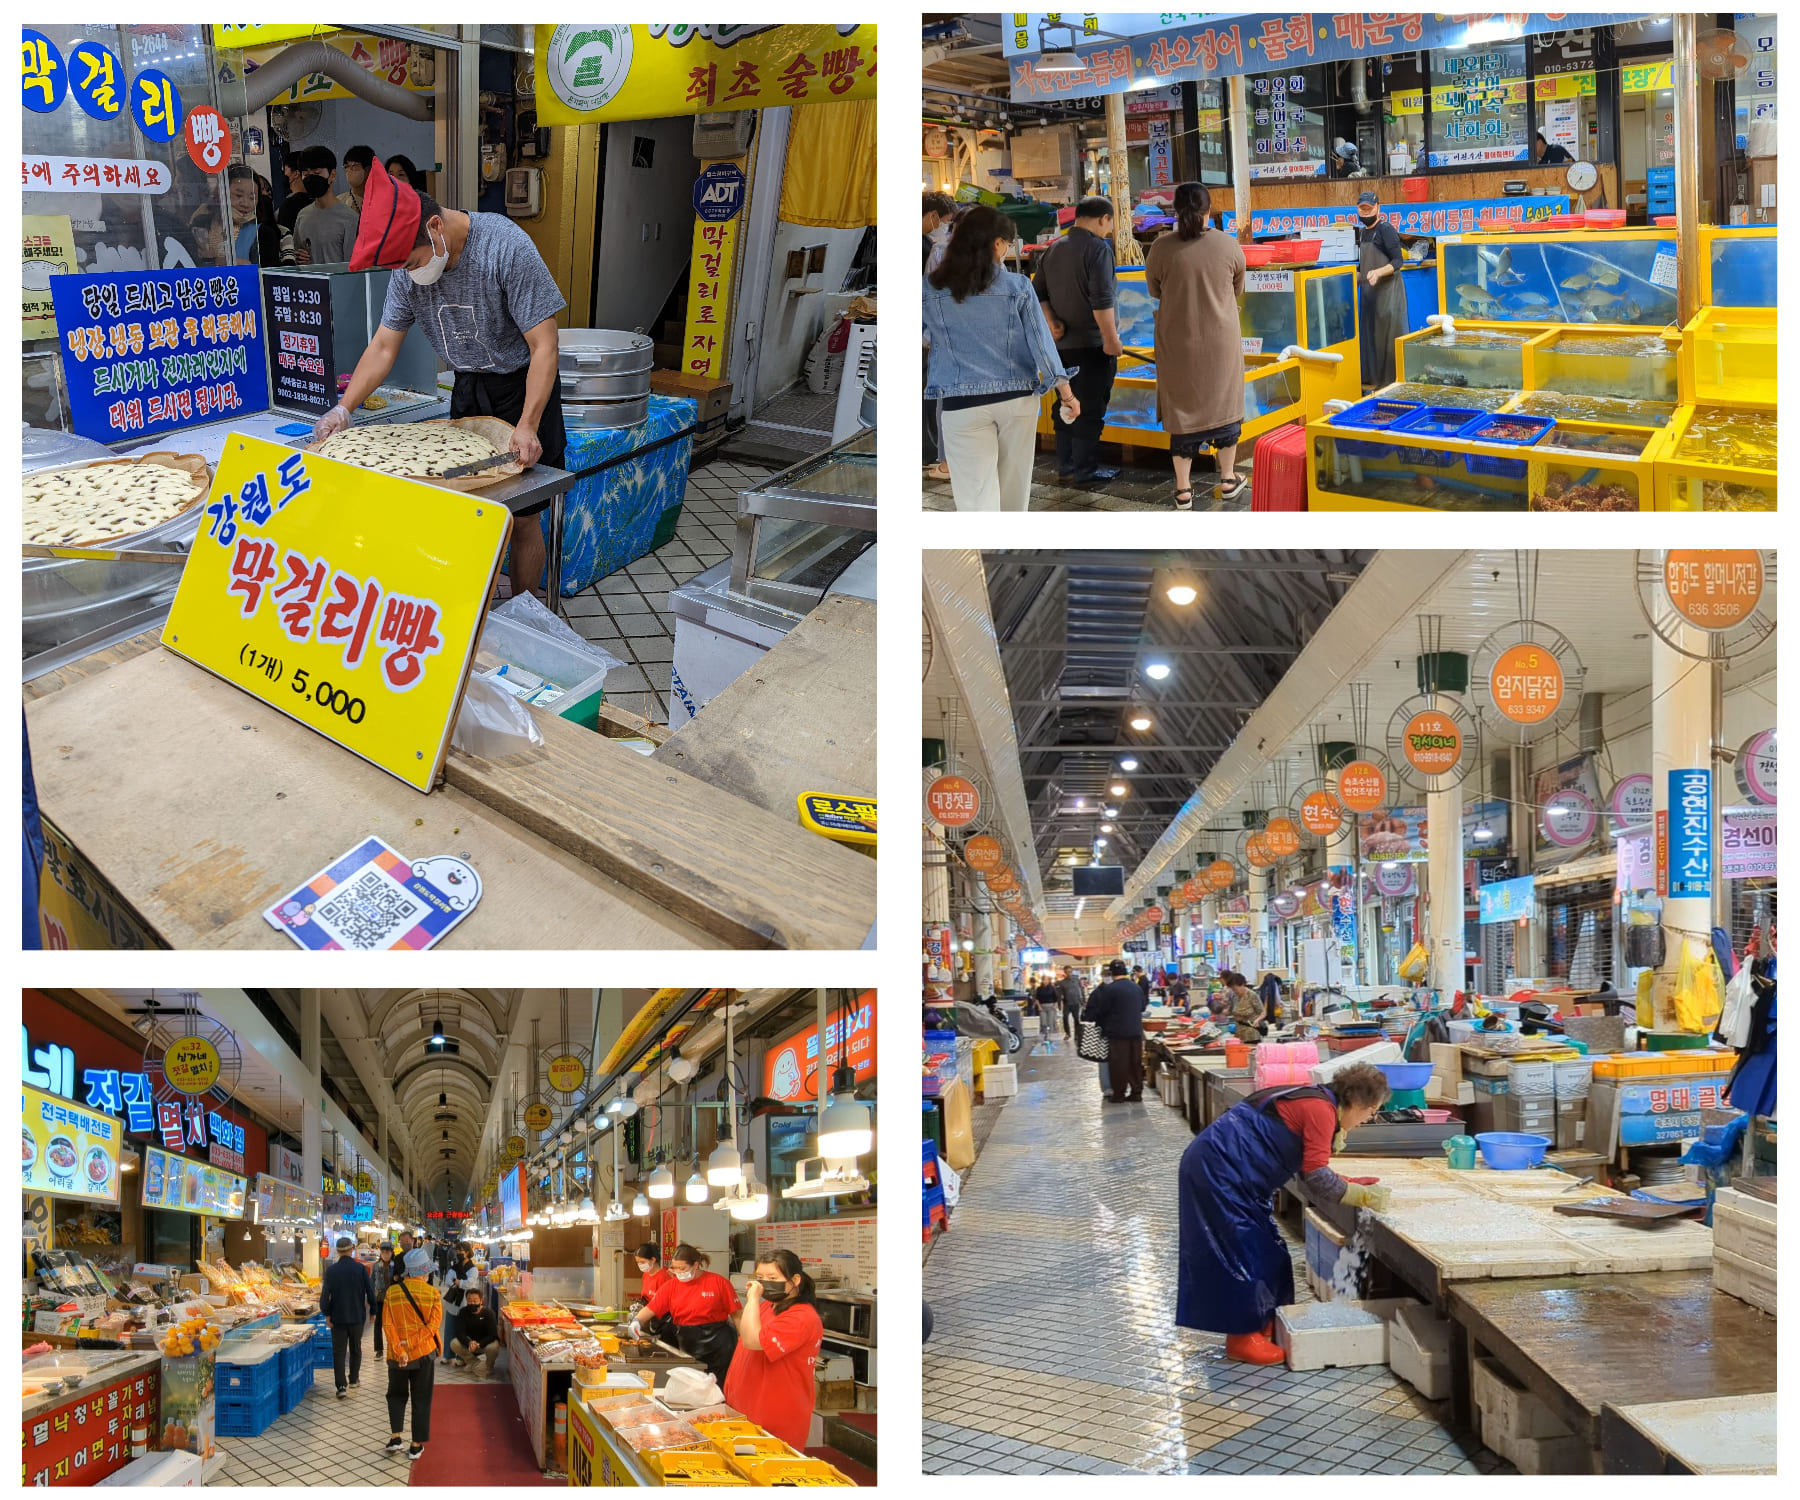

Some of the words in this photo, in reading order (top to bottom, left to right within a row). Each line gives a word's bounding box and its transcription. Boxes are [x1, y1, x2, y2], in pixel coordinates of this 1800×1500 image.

[1147, 24, 1244, 77] 산오징어
[1257, 12, 1315, 61] 물회
[685, 61, 763, 107] 최초
[61, 162, 162, 188] 주의하세요
[701, 181, 740, 204] ADT
[82, 283, 121, 320] 당일
[125, 281, 173, 313] 드시고
[176, 278, 206, 310] 남은
[209, 275, 239, 308] 빵은
[272, 286, 290, 303] 평일
[297, 289, 321, 305] 9:30
[149, 318, 180, 349] 보관
[182, 318, 198, 347] 후
[201, 309, 257, 345] 해동해서
[274, 306, 292, 323] 주말
[299, 309, 322, 326] 8:30
[282, 334, 318, 353] 정기휴일
[93, 356, 160, 396] 드시거나
[162, 345, 247, 386] 전자레인지에
[278, 352, 296, 369] 매주
[297, 355, 325, 376] 수요일
[109, 397, 144, 432] 데워
[148, 391, 192, 424] 드시면
[191, 381, 243, 416] 됩니다.
[207, 452, 312, 546] 강원도
[1668, 561, 1700, 595] 함경도
[1703, 561, 1757, 595] 할머니젓갈
[229, 537, 441, 688] 막걸리빵
[1688, 603, 1709, 616] 636
[1713, 603, 1741, 616] 3506
[239, 643, 284, 682] (1개)
[290, 668, 366, 724] 5,000
[1496, 674, 1558, 699] 엄지닭집
[1508, 704, 1524, 715] 633
[1526, 704, 1547, 715] 9347
[1420, 721, 1443, 732] 11호
[1408, 734, 1456, 751] 경선이네
[932, 792, 975, 810] 대경젓갈
[1681, 774, 1709, 878] 공현진수산
[172, 1063, 189, 1076] 젓갈
[190, 1062, 208, 1076] 멸치
[84, 1068, 155, 1132] 젓갈
[157, 1101, 207, 1152] 멸치
[209, 1110, 245, 1154] 백화점
[1650, 1087, 1690, 1113] 명태
[41, 1101, 112, 1140] 전국택배전문
